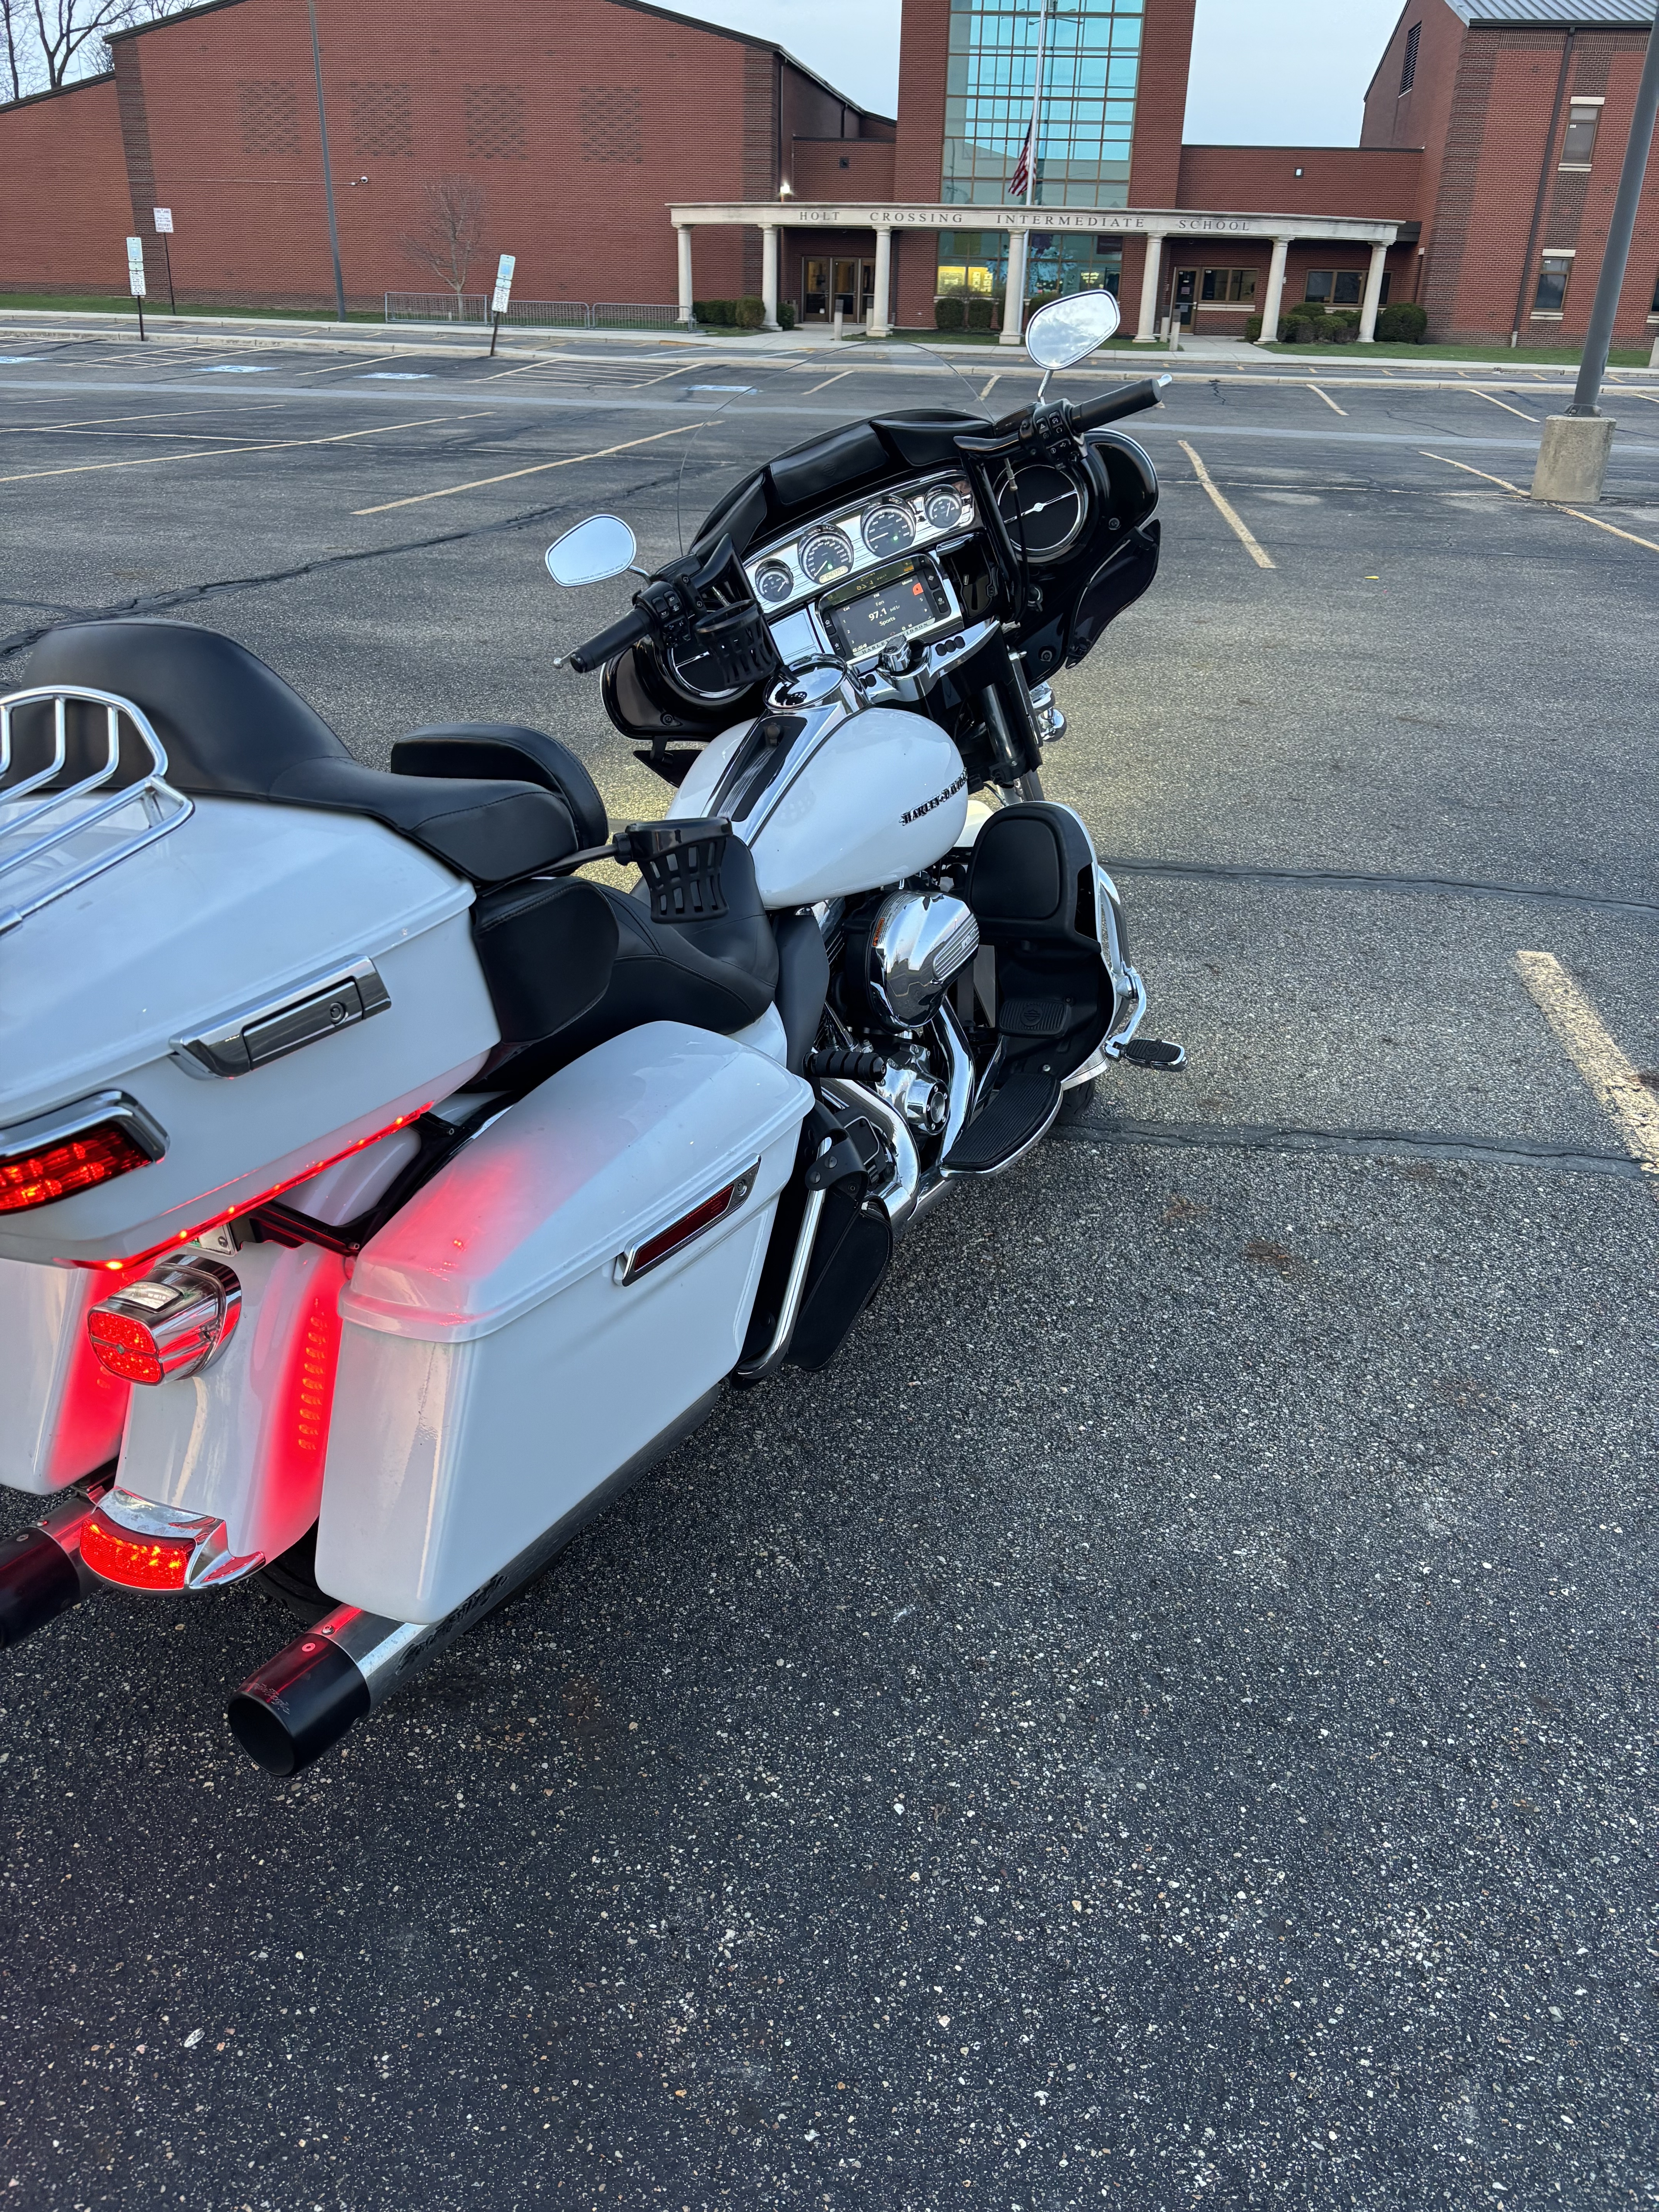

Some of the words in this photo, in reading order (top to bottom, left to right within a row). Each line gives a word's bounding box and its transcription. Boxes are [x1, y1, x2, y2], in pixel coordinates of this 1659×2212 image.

[800, 212, 840, 220] HOLT
[870, 212, 962, 222] CROSSING
[997, 215, 1144, 227] INTERMEDIATE
[1179, 220, 1249, 231] SCHOOL
[869, 608, 887, 621] 97.1
[879, 616, 896, 626] Sports
